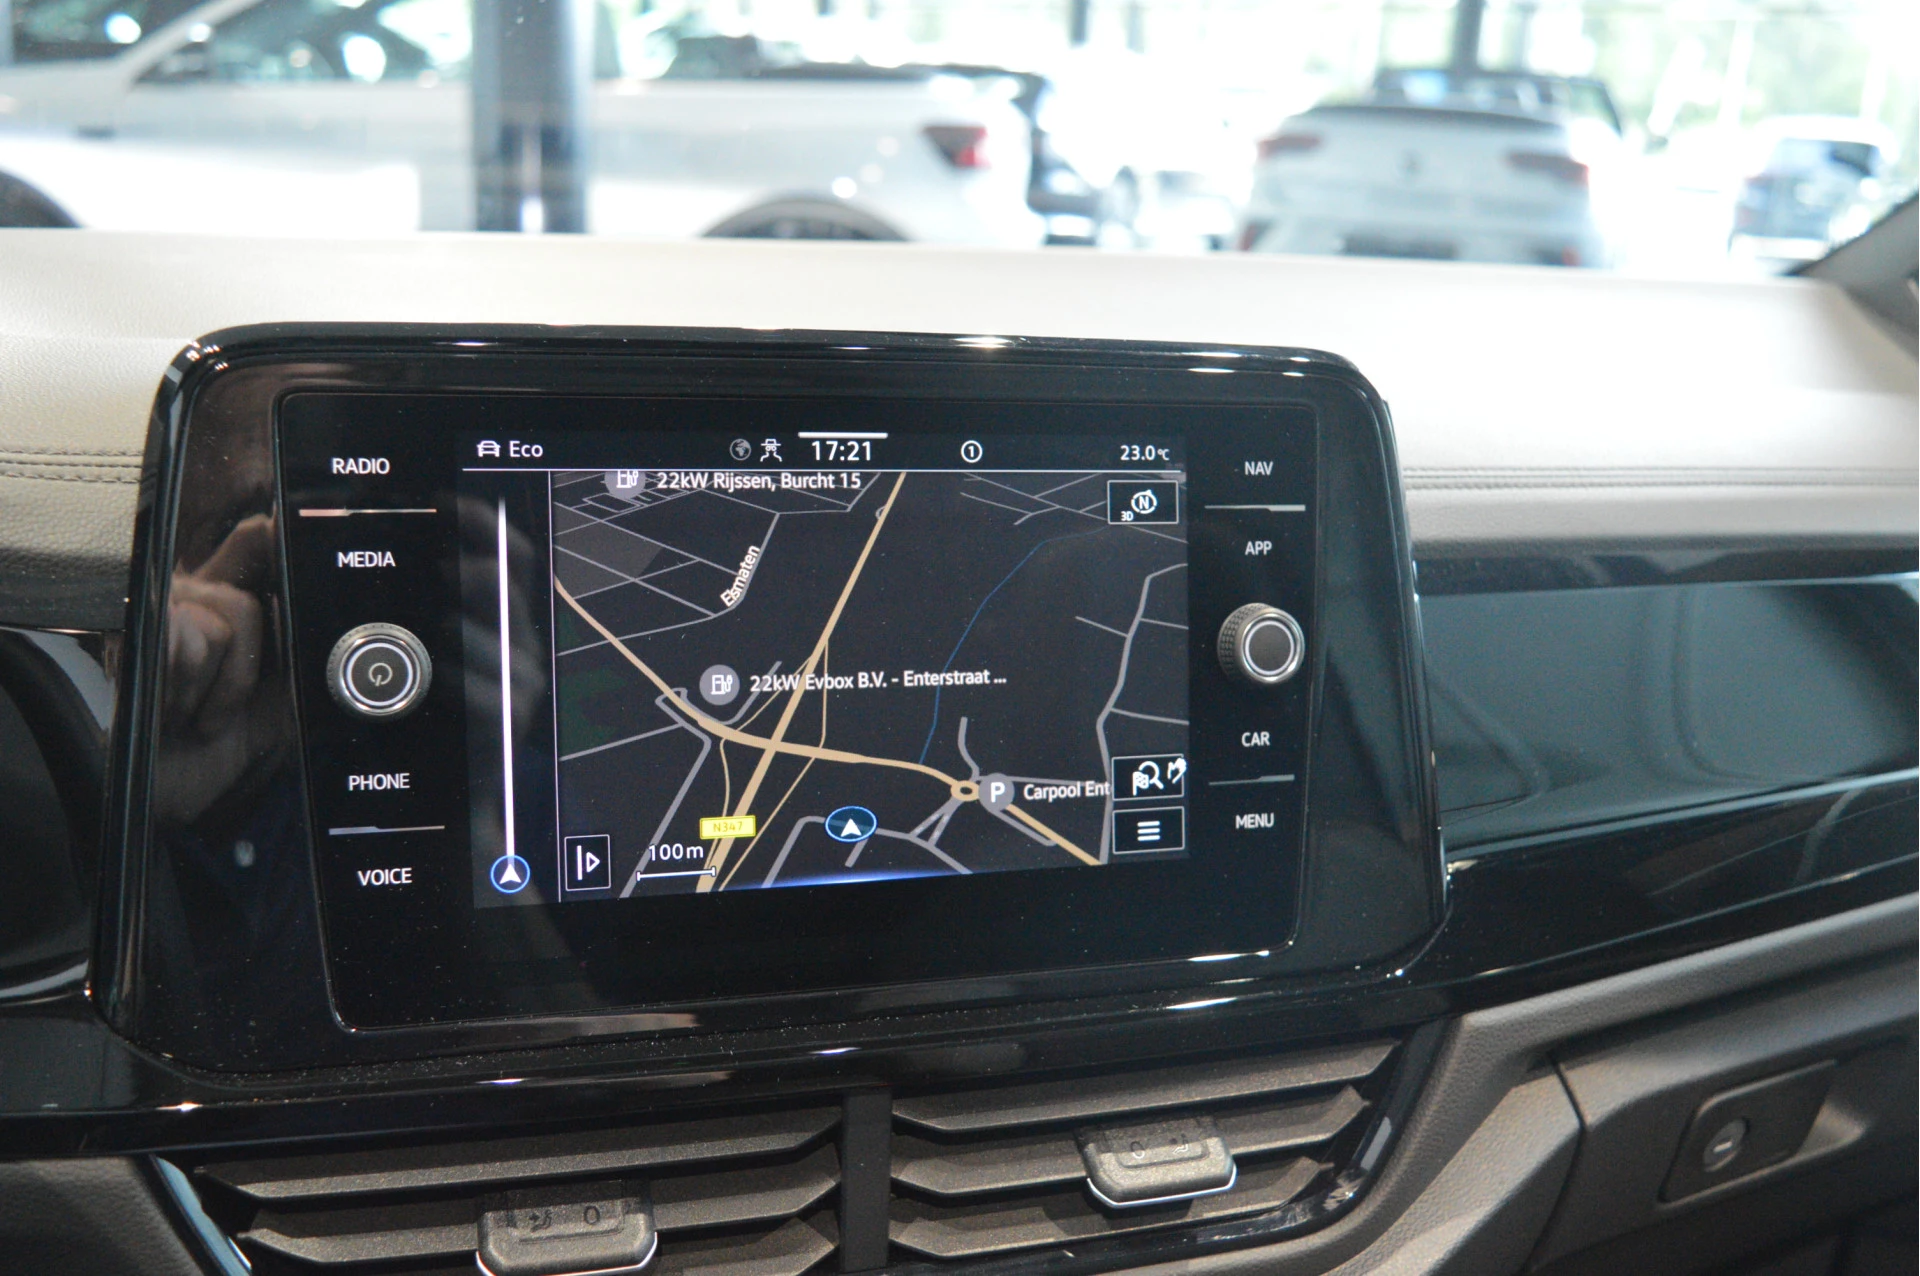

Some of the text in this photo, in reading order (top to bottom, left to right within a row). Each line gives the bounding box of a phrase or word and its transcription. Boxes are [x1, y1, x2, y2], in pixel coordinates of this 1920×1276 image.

[509, 441, 543, 458] Eco
[811, 440, 872, 462] 17:21
[331, 457, 391, 475] RADIO
[1244, 461, 1274, 476] NAV
[657, 472, 861, 493] 22kW Rijssen, Burcht 15
[1120, 511, 1134, 522] 3D
[1245, 540, 1273, 556] APP
[337, 551, 396, 569] MEDIA
[720, 545, 760, 608] Esmaten
[750, 673, 801, 693] 22kW
[805, 673, 854, 690] Evbox
[858, 671, 887, 688] B.V.
[903, 669, 991, 687] Enterstraat
[1241, 731, 1271, 747] CAR
[348, 772, 411, 791] PHONE
[1023, 781, 1081, 802] Carpool
[713, 821, 743, 832] N347
[1235, 812, 1275, 829] MENU
[357, 867, 412, 886] VOICE
